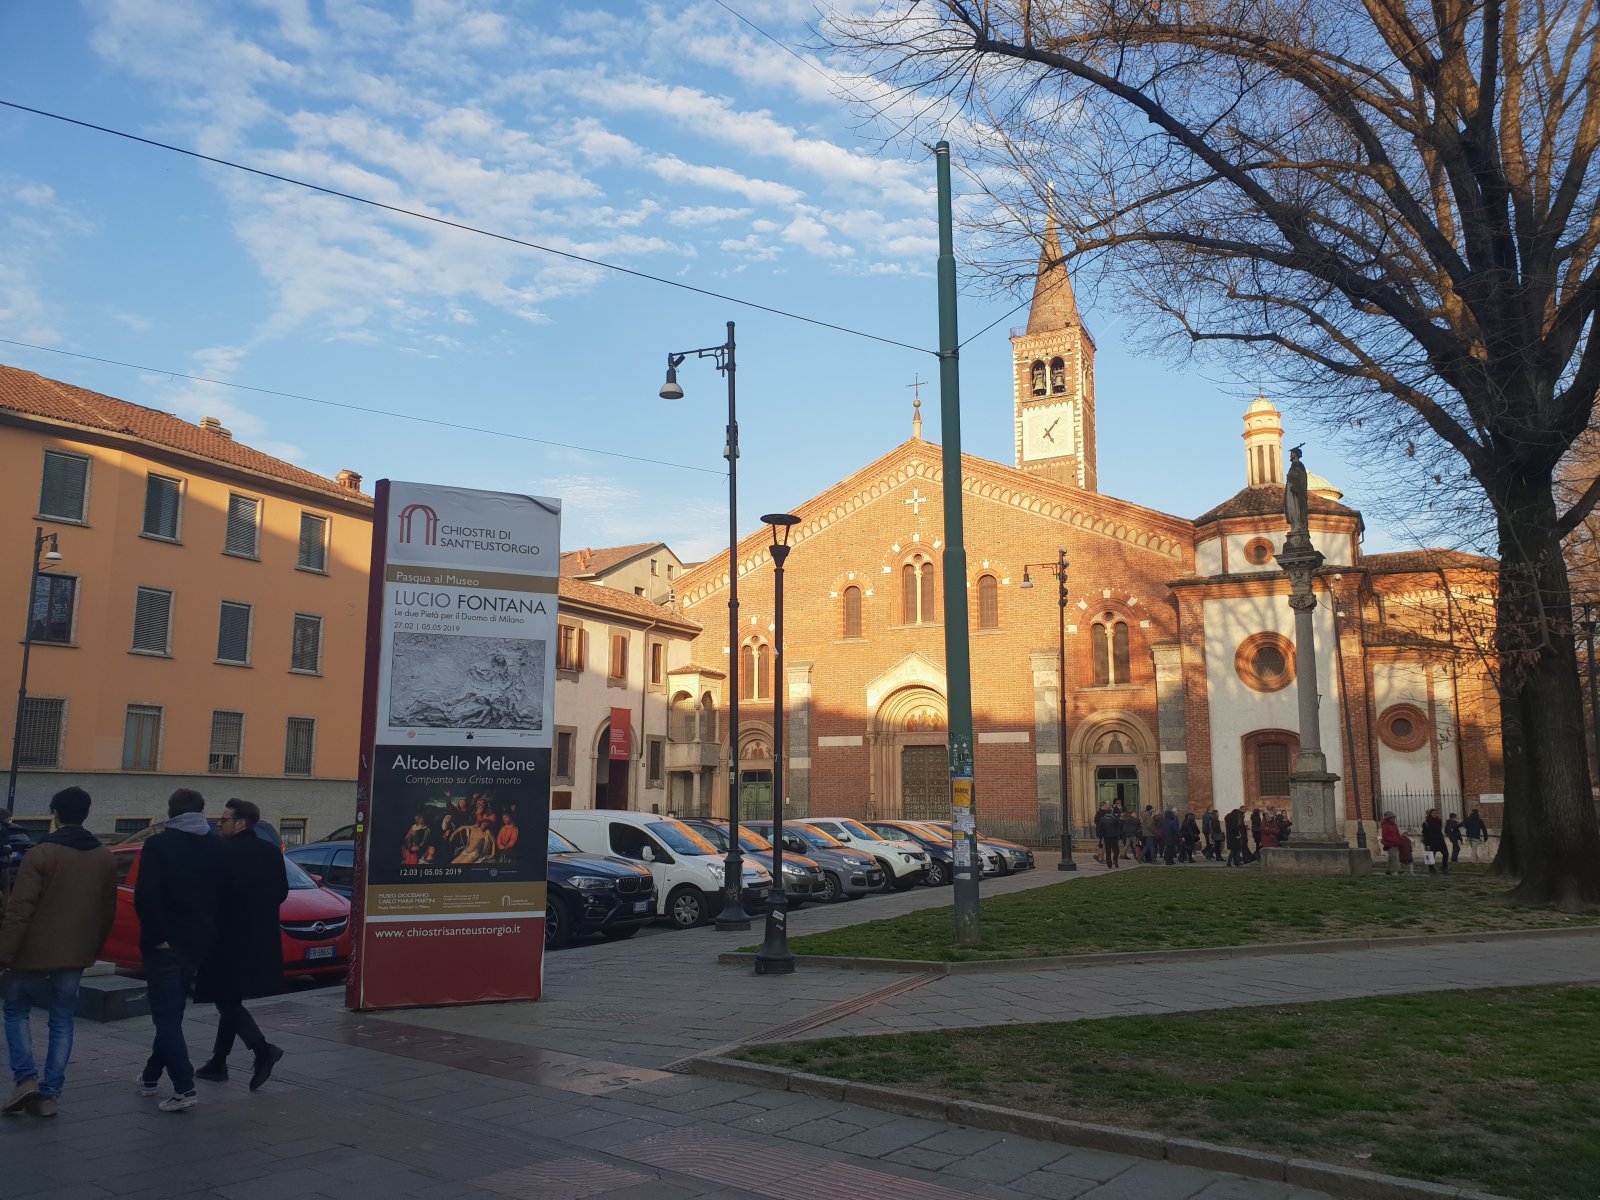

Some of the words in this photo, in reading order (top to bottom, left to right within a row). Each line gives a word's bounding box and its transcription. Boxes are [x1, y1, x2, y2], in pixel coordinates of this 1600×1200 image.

[441, 525, 496, 539] CHIOSTRI
[499, 530, 511, 540] DI
[440, 538, 540, 555] SANT'EUSTORGIO
[396, 571, 431, 584] Pasqua
[434, 574, 443, 583] al
[446, 574, 480, 586] Museo
[395, 589, 451, 608] LUCIO
[458, 594, 547, 615] FONTANA
[394, 608, 403, 616] Le
[404, 609, 419, 617] due
[420, 610, 439, 619] Pietà
[455, 612, 460, 620] il
[461, 612, 488, 622] Duomo
[489, 614, 497, 622] di
[498, 615, 525, 624] Milano
[394, 621, 414, 629] 27.02
[421, 623, 442, 631] 05.05
[443, 624, 461, 632] 2019
[392, 754, 470, 771] Altobello
[476, 755, 536, 771] Melone
[405, 774, 454, 786] Compianto
[469, 775, 494, 785] Cristo
[496, 777, 522, 785] morto
[399, 868, 418, 876] 12.03
[424, 868, 443, 876] 05.05
[445, 867, 462, 876] 2019
[407, 924, 521, 938] chiostrisanteustorgio.it
